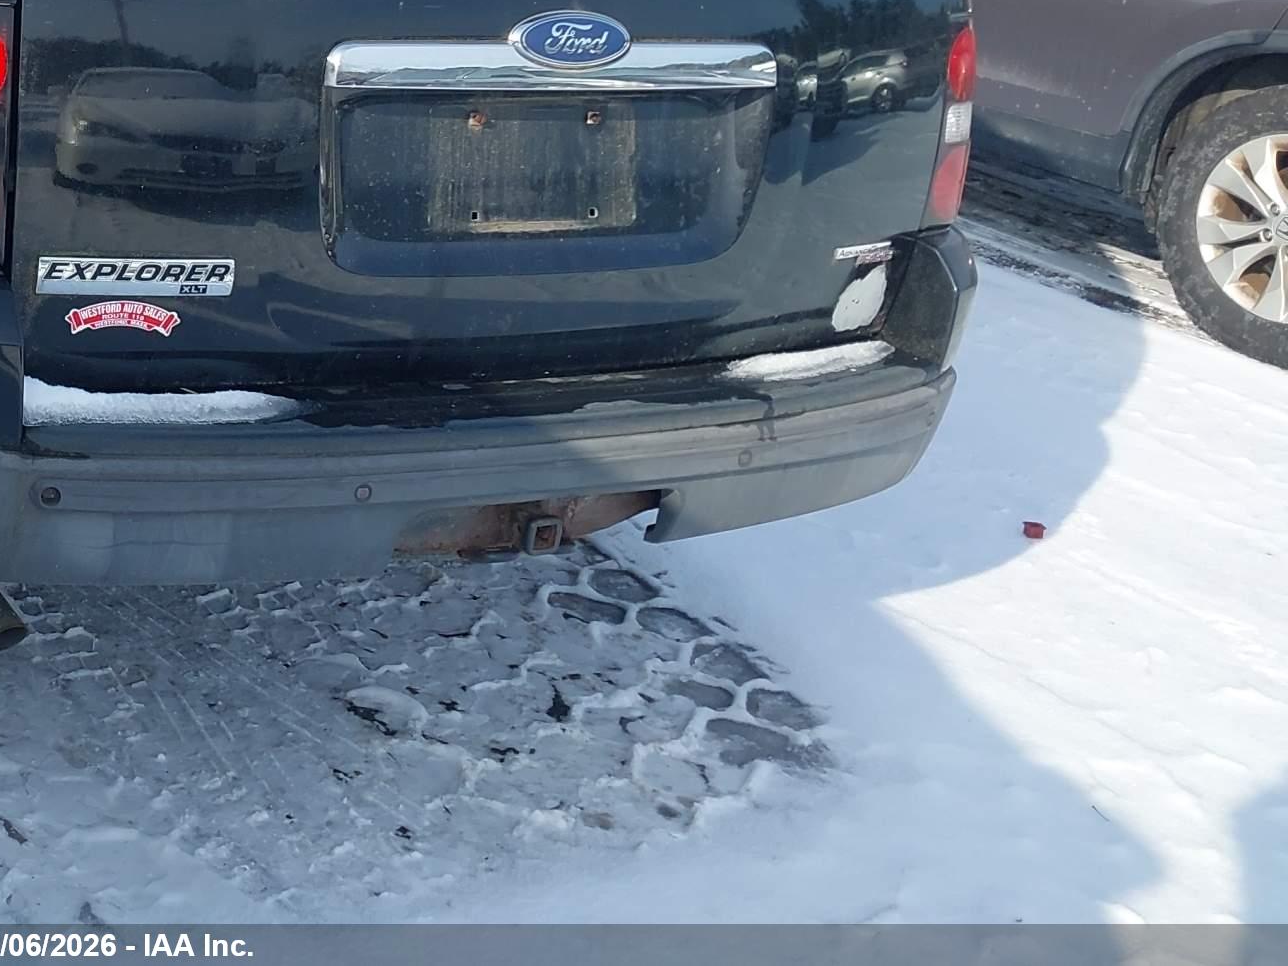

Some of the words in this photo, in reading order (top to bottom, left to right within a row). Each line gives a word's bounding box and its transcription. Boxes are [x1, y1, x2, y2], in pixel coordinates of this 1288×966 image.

[544, 22, 609, 54] Ford
[43, 262, 231, 282] EXPLORER
[181, 285, 207, 294] XLT
[79, 303, 122, 320] WESTFORD
[123, 303, 144, 315] AUTO
[143, 306, 168, 322] SALES
